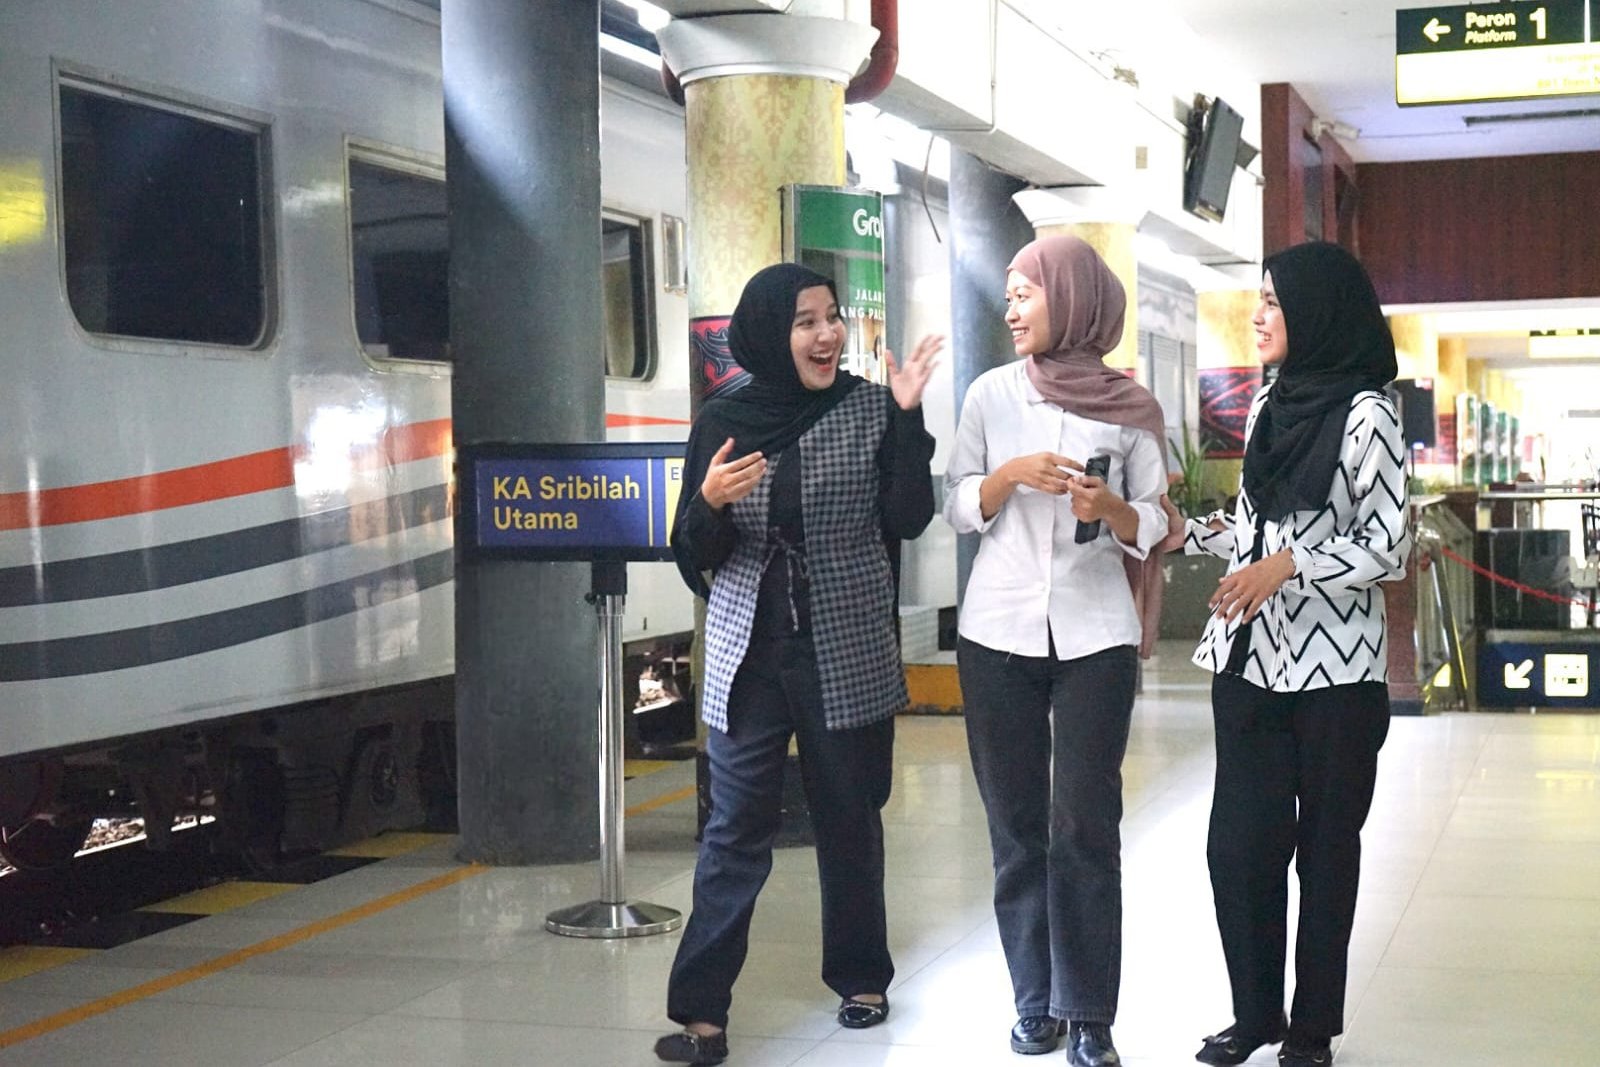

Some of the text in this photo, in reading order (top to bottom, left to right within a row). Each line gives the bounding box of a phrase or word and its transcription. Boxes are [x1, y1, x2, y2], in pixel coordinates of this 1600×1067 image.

[1465, 7, 1547, 40] Peron 1
[1465, 29, 1517, 44] Platform
[493, 475, 640, 500] KA Sribilah
[493, 506, 578, 530] Utama
